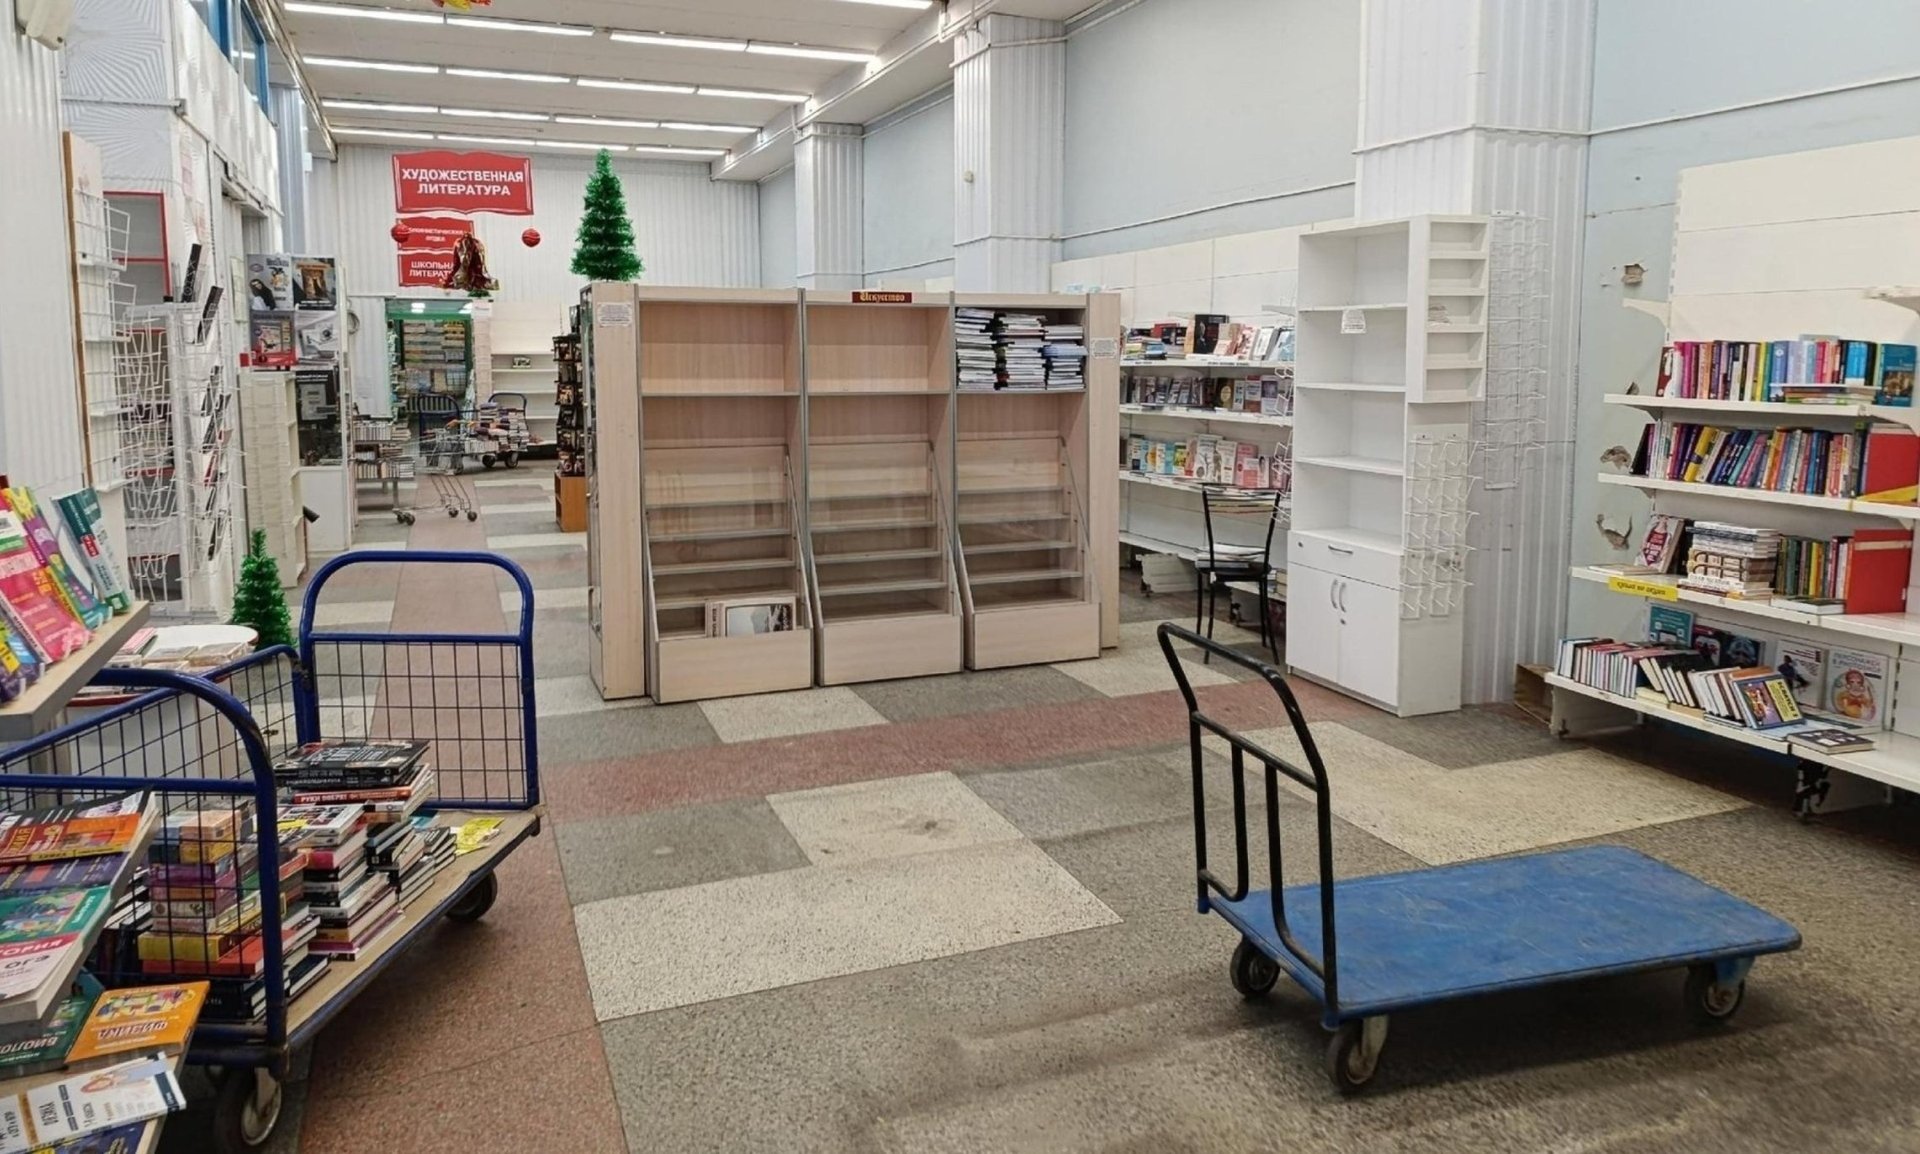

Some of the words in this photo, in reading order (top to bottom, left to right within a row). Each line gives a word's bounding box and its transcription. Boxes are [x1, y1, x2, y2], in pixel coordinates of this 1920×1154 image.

[402, 168, 524, 183] ХУДОЖЕСТВЕННАЯ
[417, 183, 511, 196] ЛИТЕРАТУРА
[409, 269, 452, 278] ЛИТЕРАТ
[0, 938, 63, 956] ОРИЯ
[98, 1019, 168, 1040] ФИЗИКА
